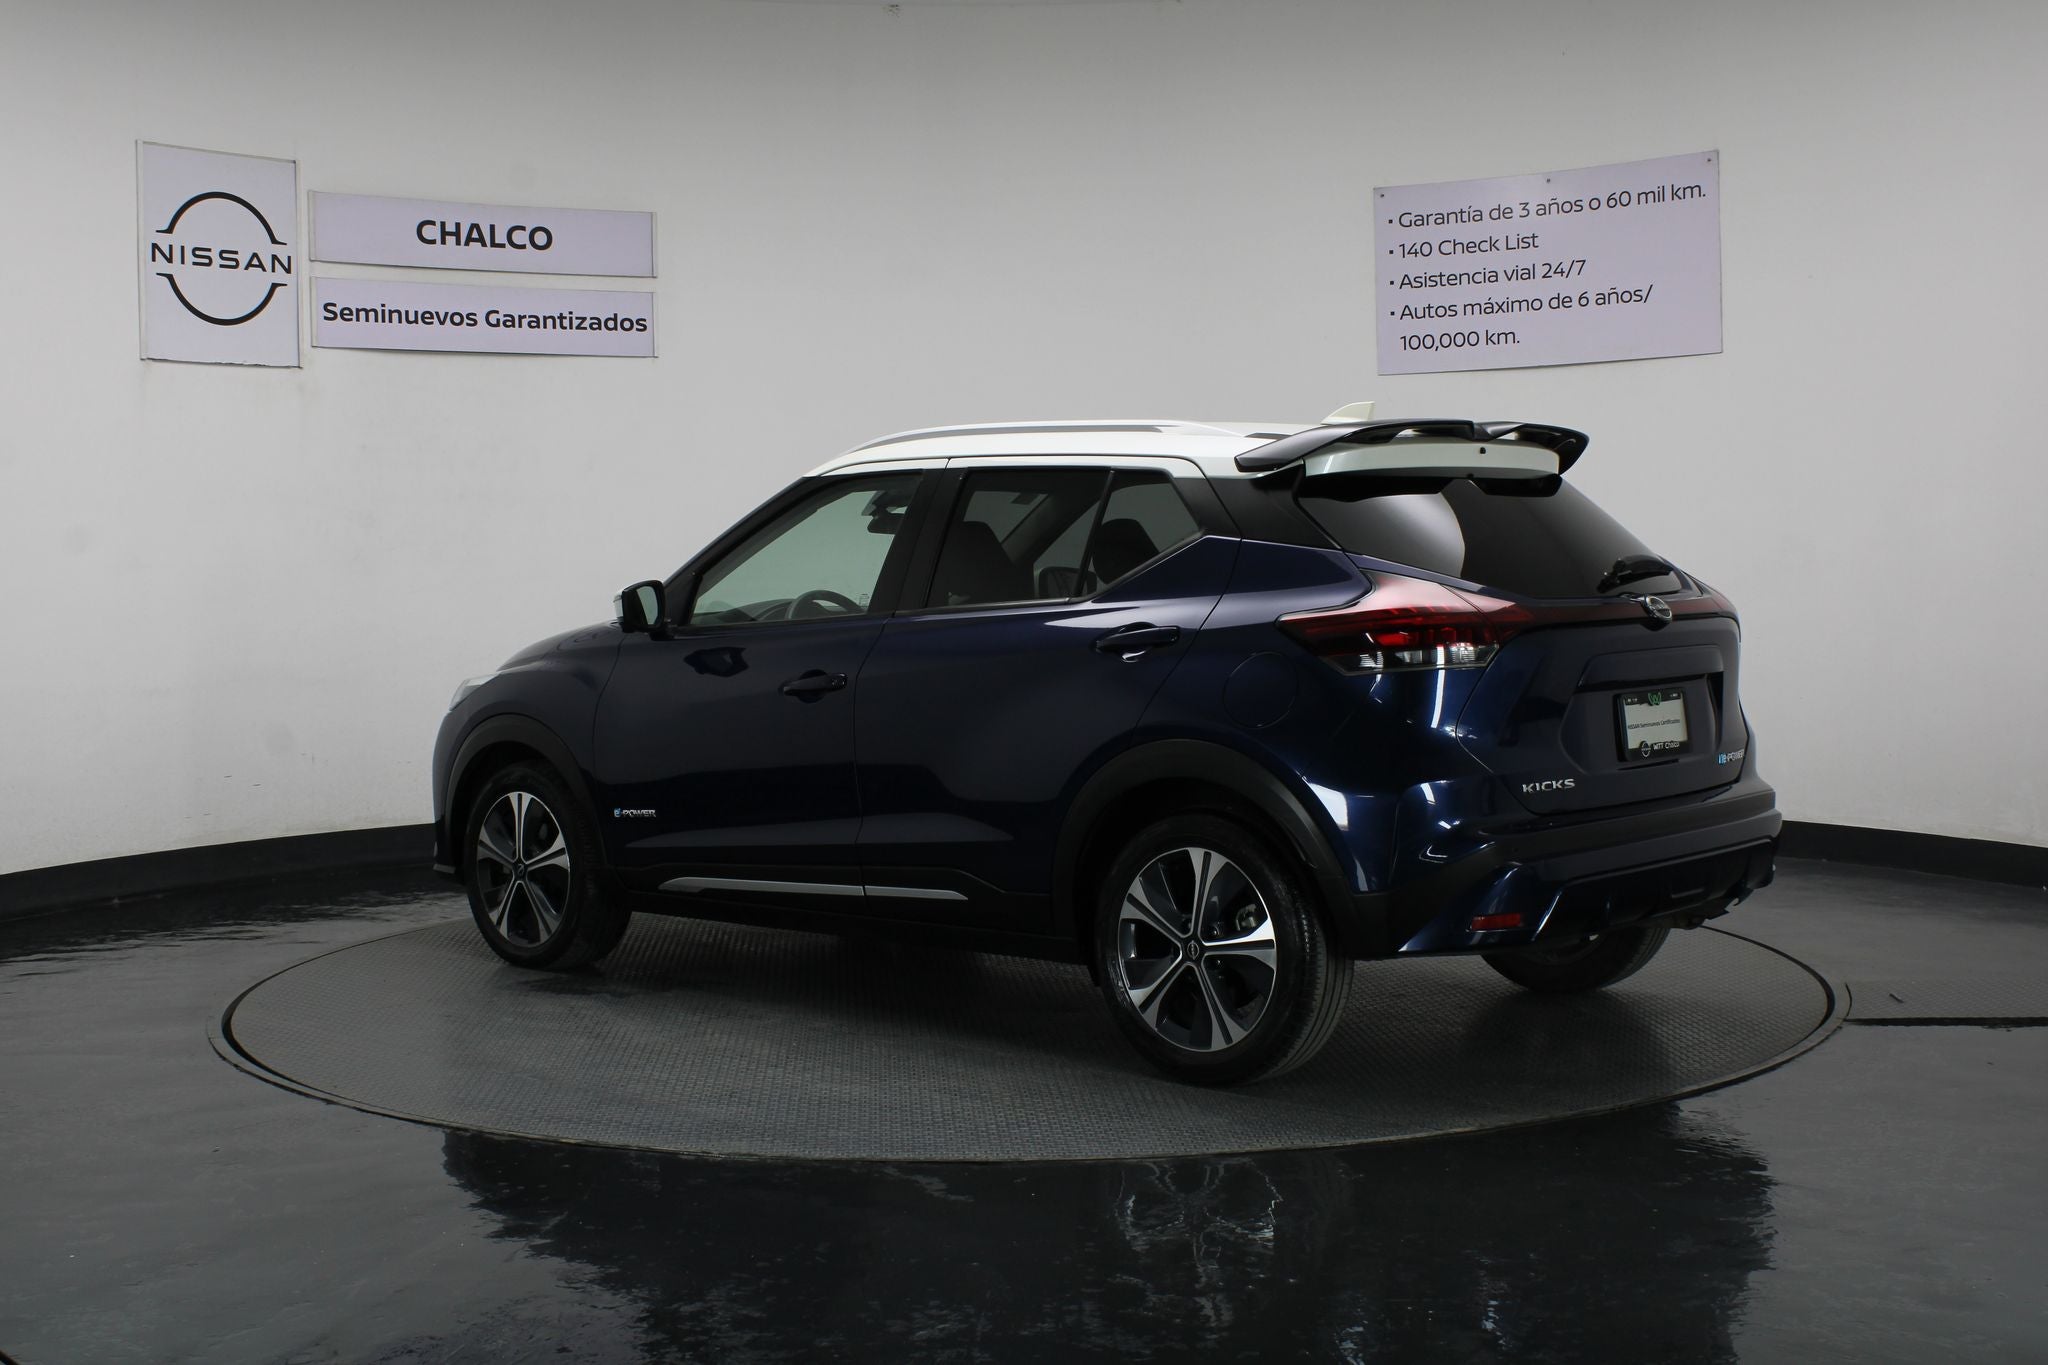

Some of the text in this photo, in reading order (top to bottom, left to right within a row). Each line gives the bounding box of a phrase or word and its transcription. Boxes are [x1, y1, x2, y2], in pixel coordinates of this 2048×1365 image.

[1399, 181, 1707, 228] Garantía de 3 años o 60 mil km.
[416, 219, 554, 251] CHALCO
[1398, 232, 1540, 259] 140 Check List
[151, 242, 292, 275] NISSAN
[1399, 259, 1587, 290] Asistencia vial 24/7
[322, 301, 648, 333] Seminuevos Garantizados
[1400, 283, 1654, 321] Autos máximo de 6 años/
[1400, 329, 1521, 352] 100,000 km.
[1522, 778, 1576, 793] KICKS
